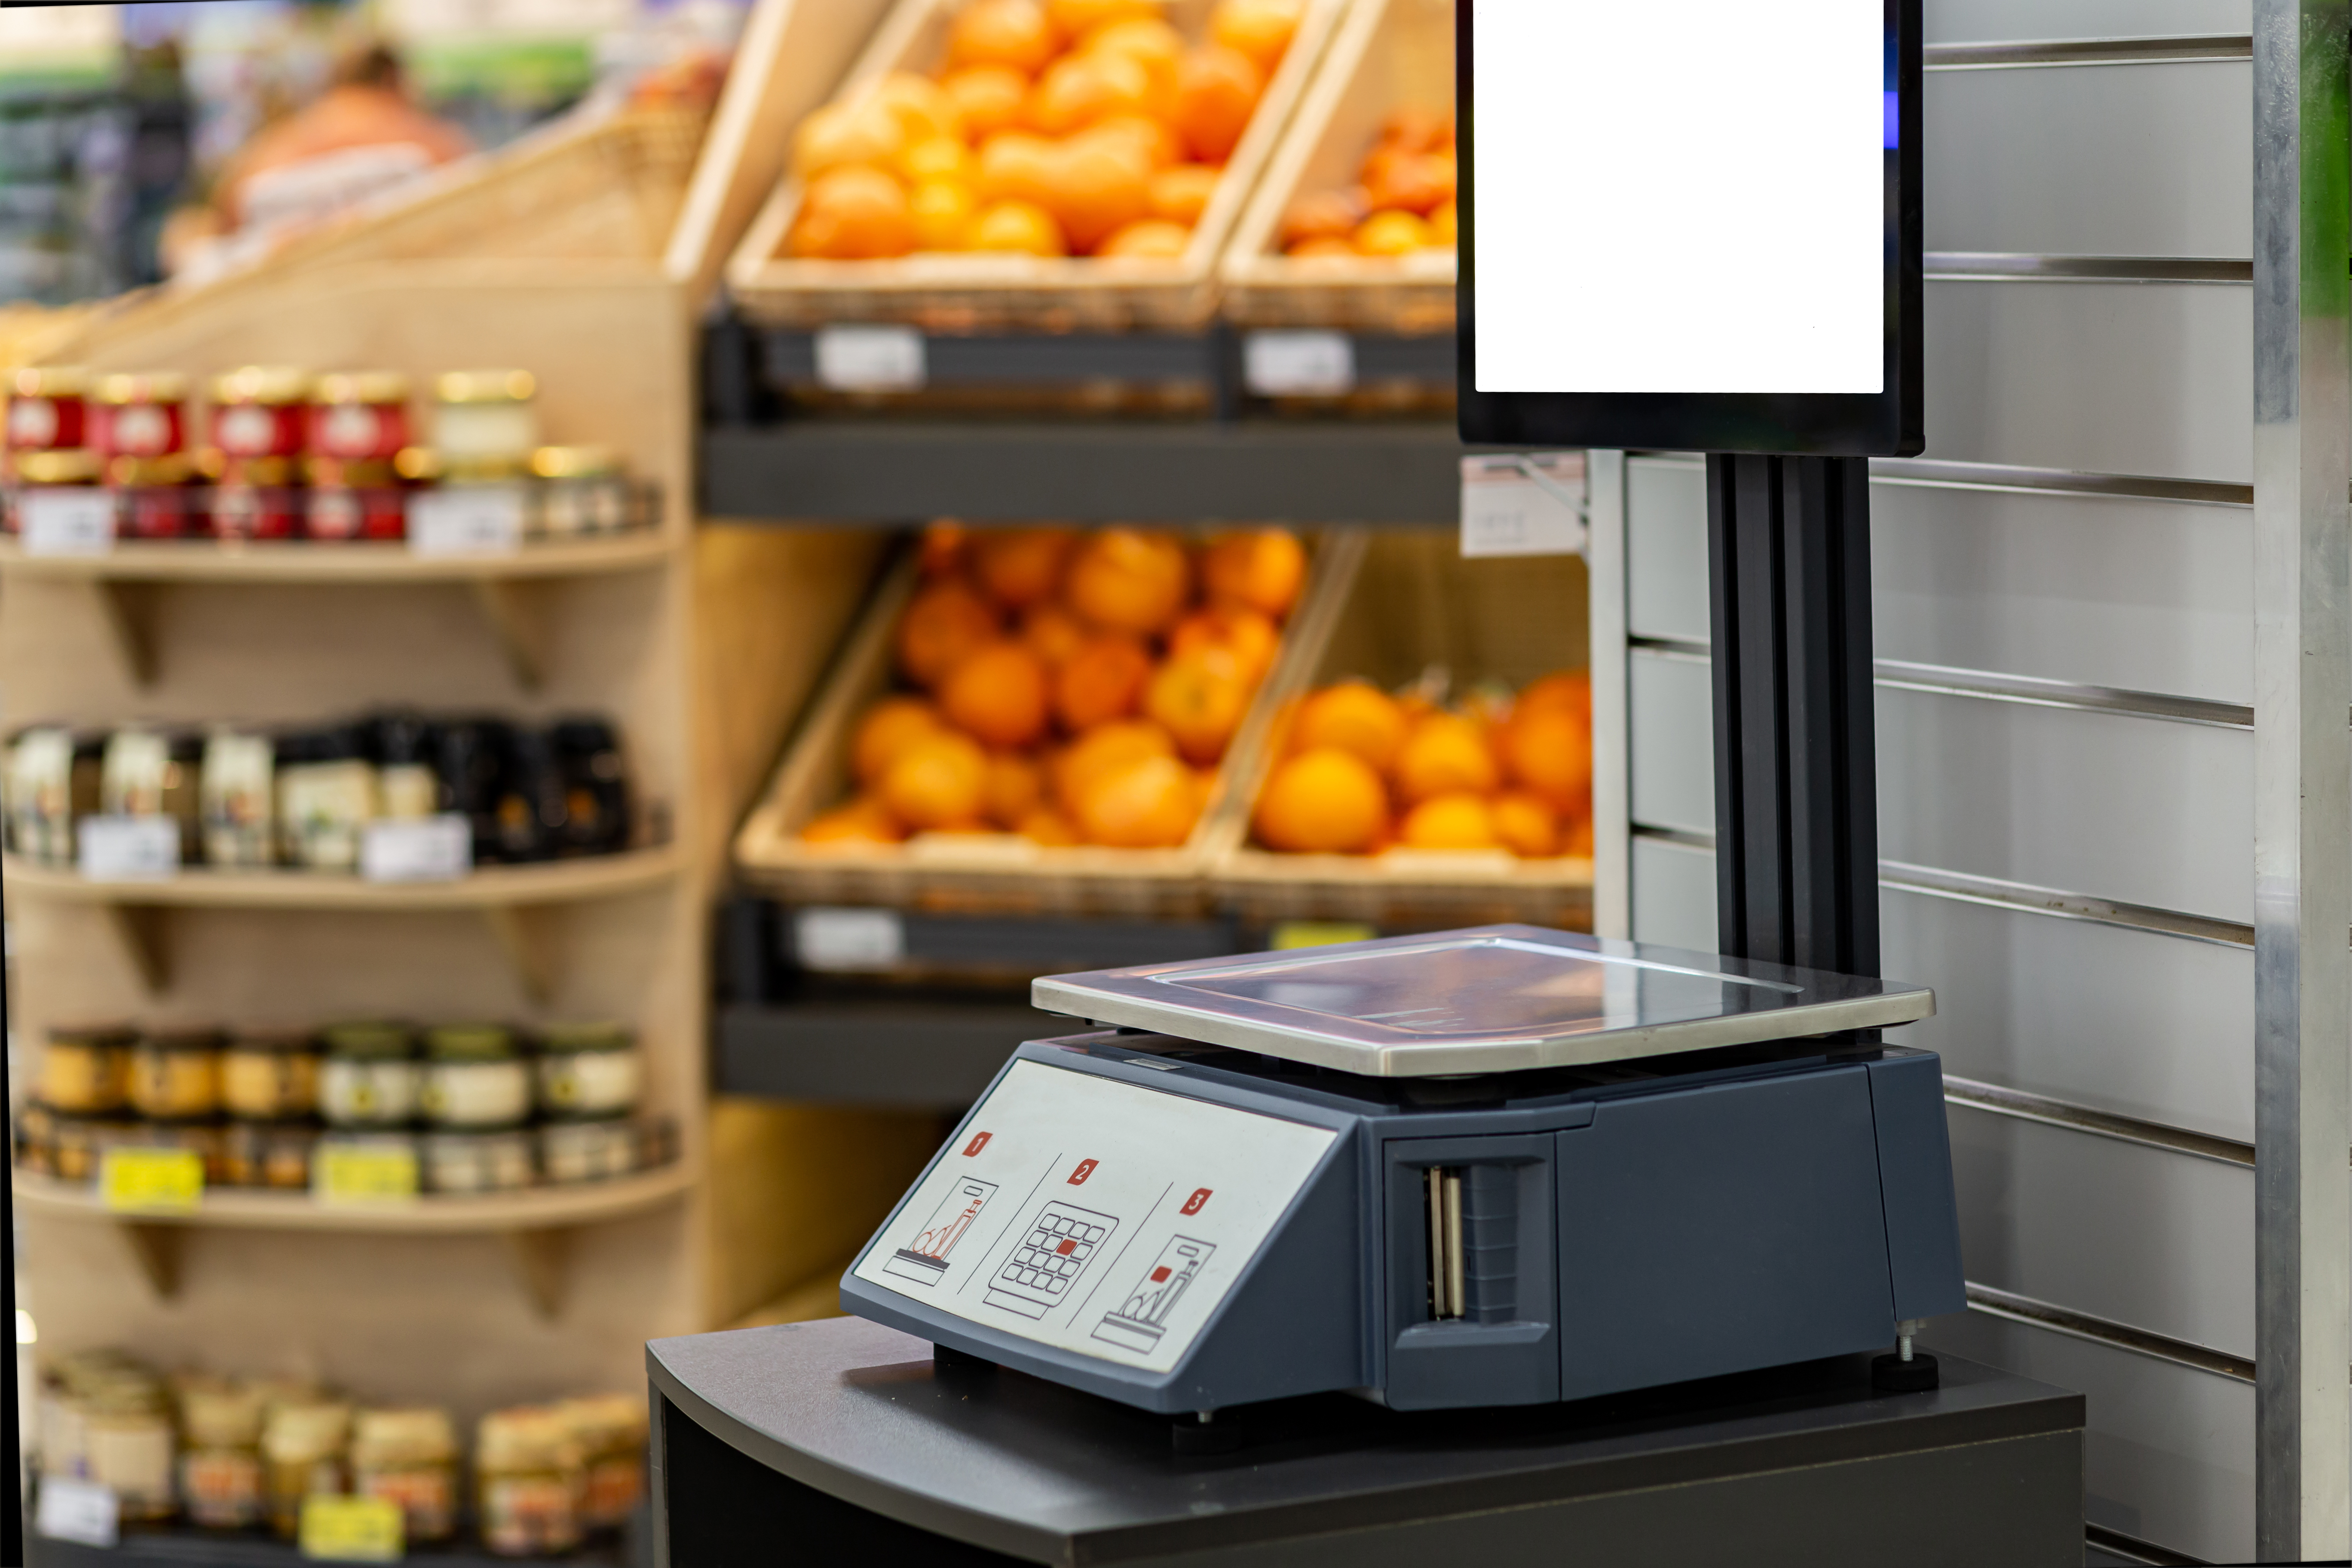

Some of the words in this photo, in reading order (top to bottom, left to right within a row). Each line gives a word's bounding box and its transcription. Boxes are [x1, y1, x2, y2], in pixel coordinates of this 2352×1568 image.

[972, 1137, 984, 1152] 1
[1075, 1164, 1090, 1180] 2
[1188, 1194, 1204, 1210] 3
